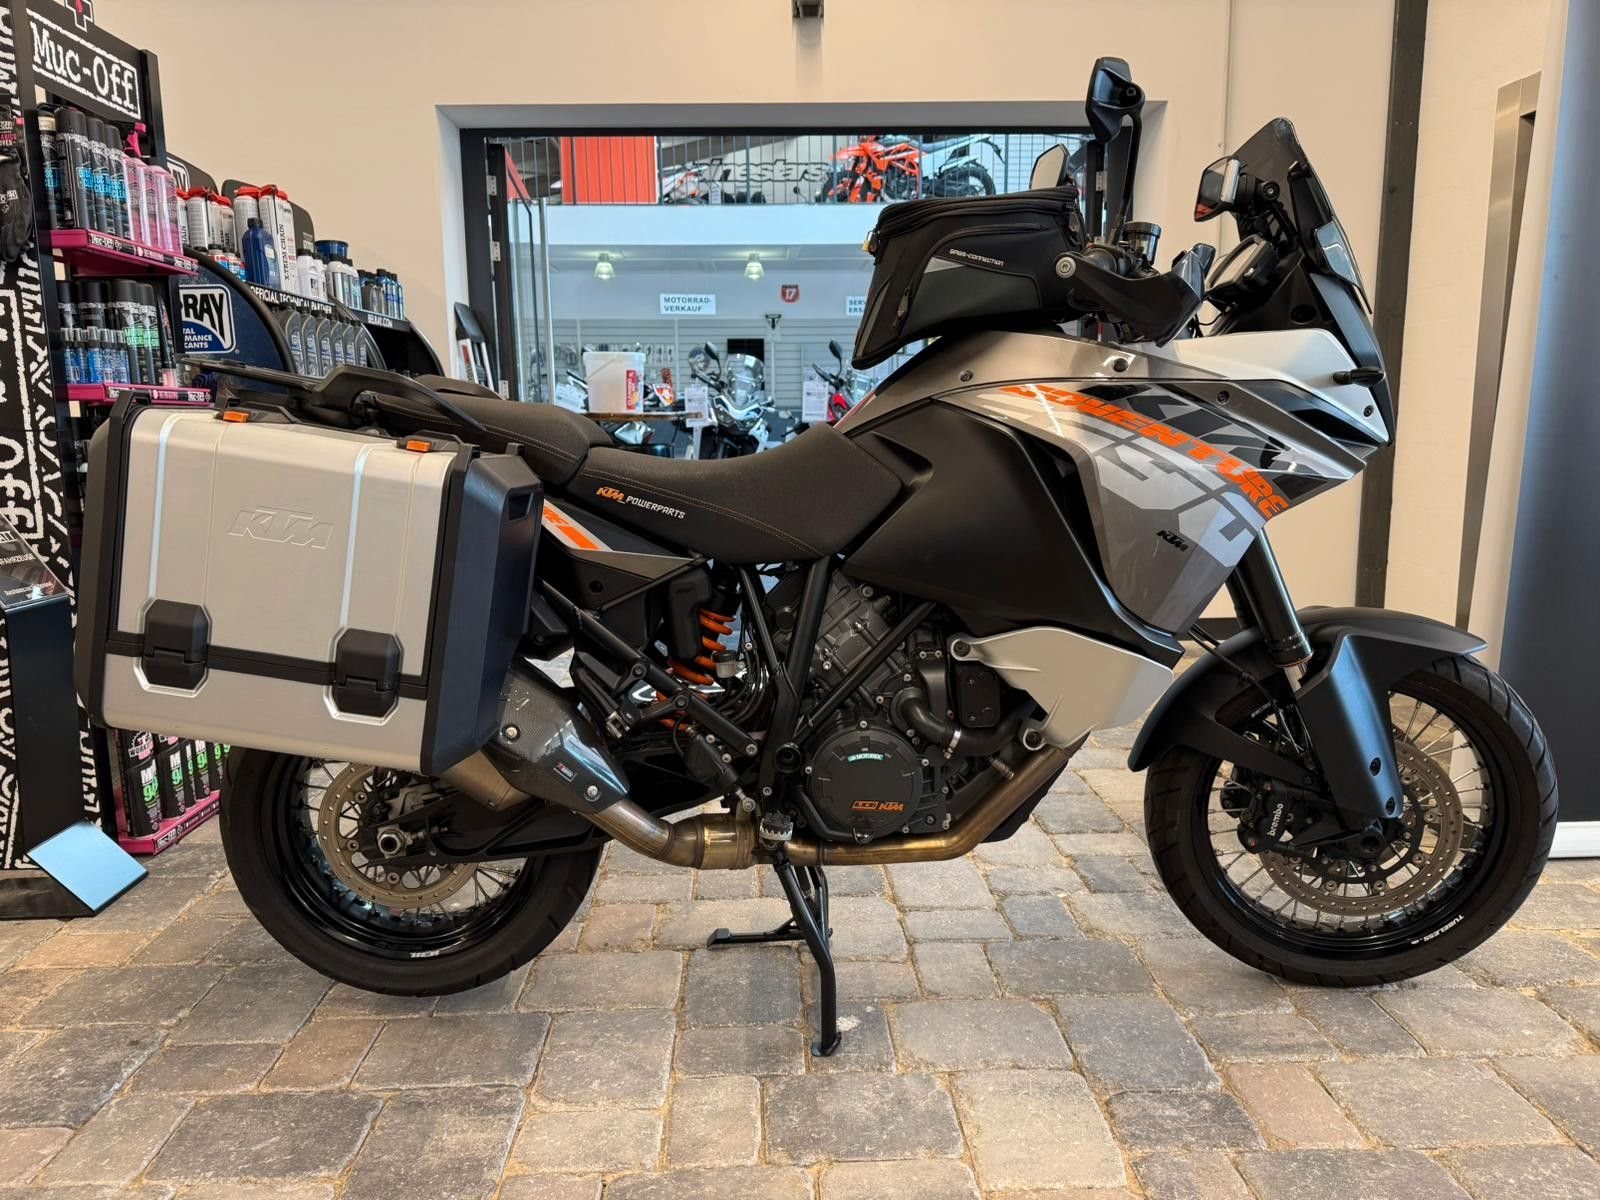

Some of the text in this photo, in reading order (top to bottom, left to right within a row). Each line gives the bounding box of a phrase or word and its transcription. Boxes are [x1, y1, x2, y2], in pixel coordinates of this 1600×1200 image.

[30, 21, 137, 109] Muc-Off
[250, 285, 279, 304] OFFICIAL
[663, 296, 713, 304] MOTORRAD-
[181, 293, 226, 341] RAY
[227, 505, 335, 550] KTM
[1156, 530, 1189, 552] KTM
[1266, 803, 1284, 836] brembo
